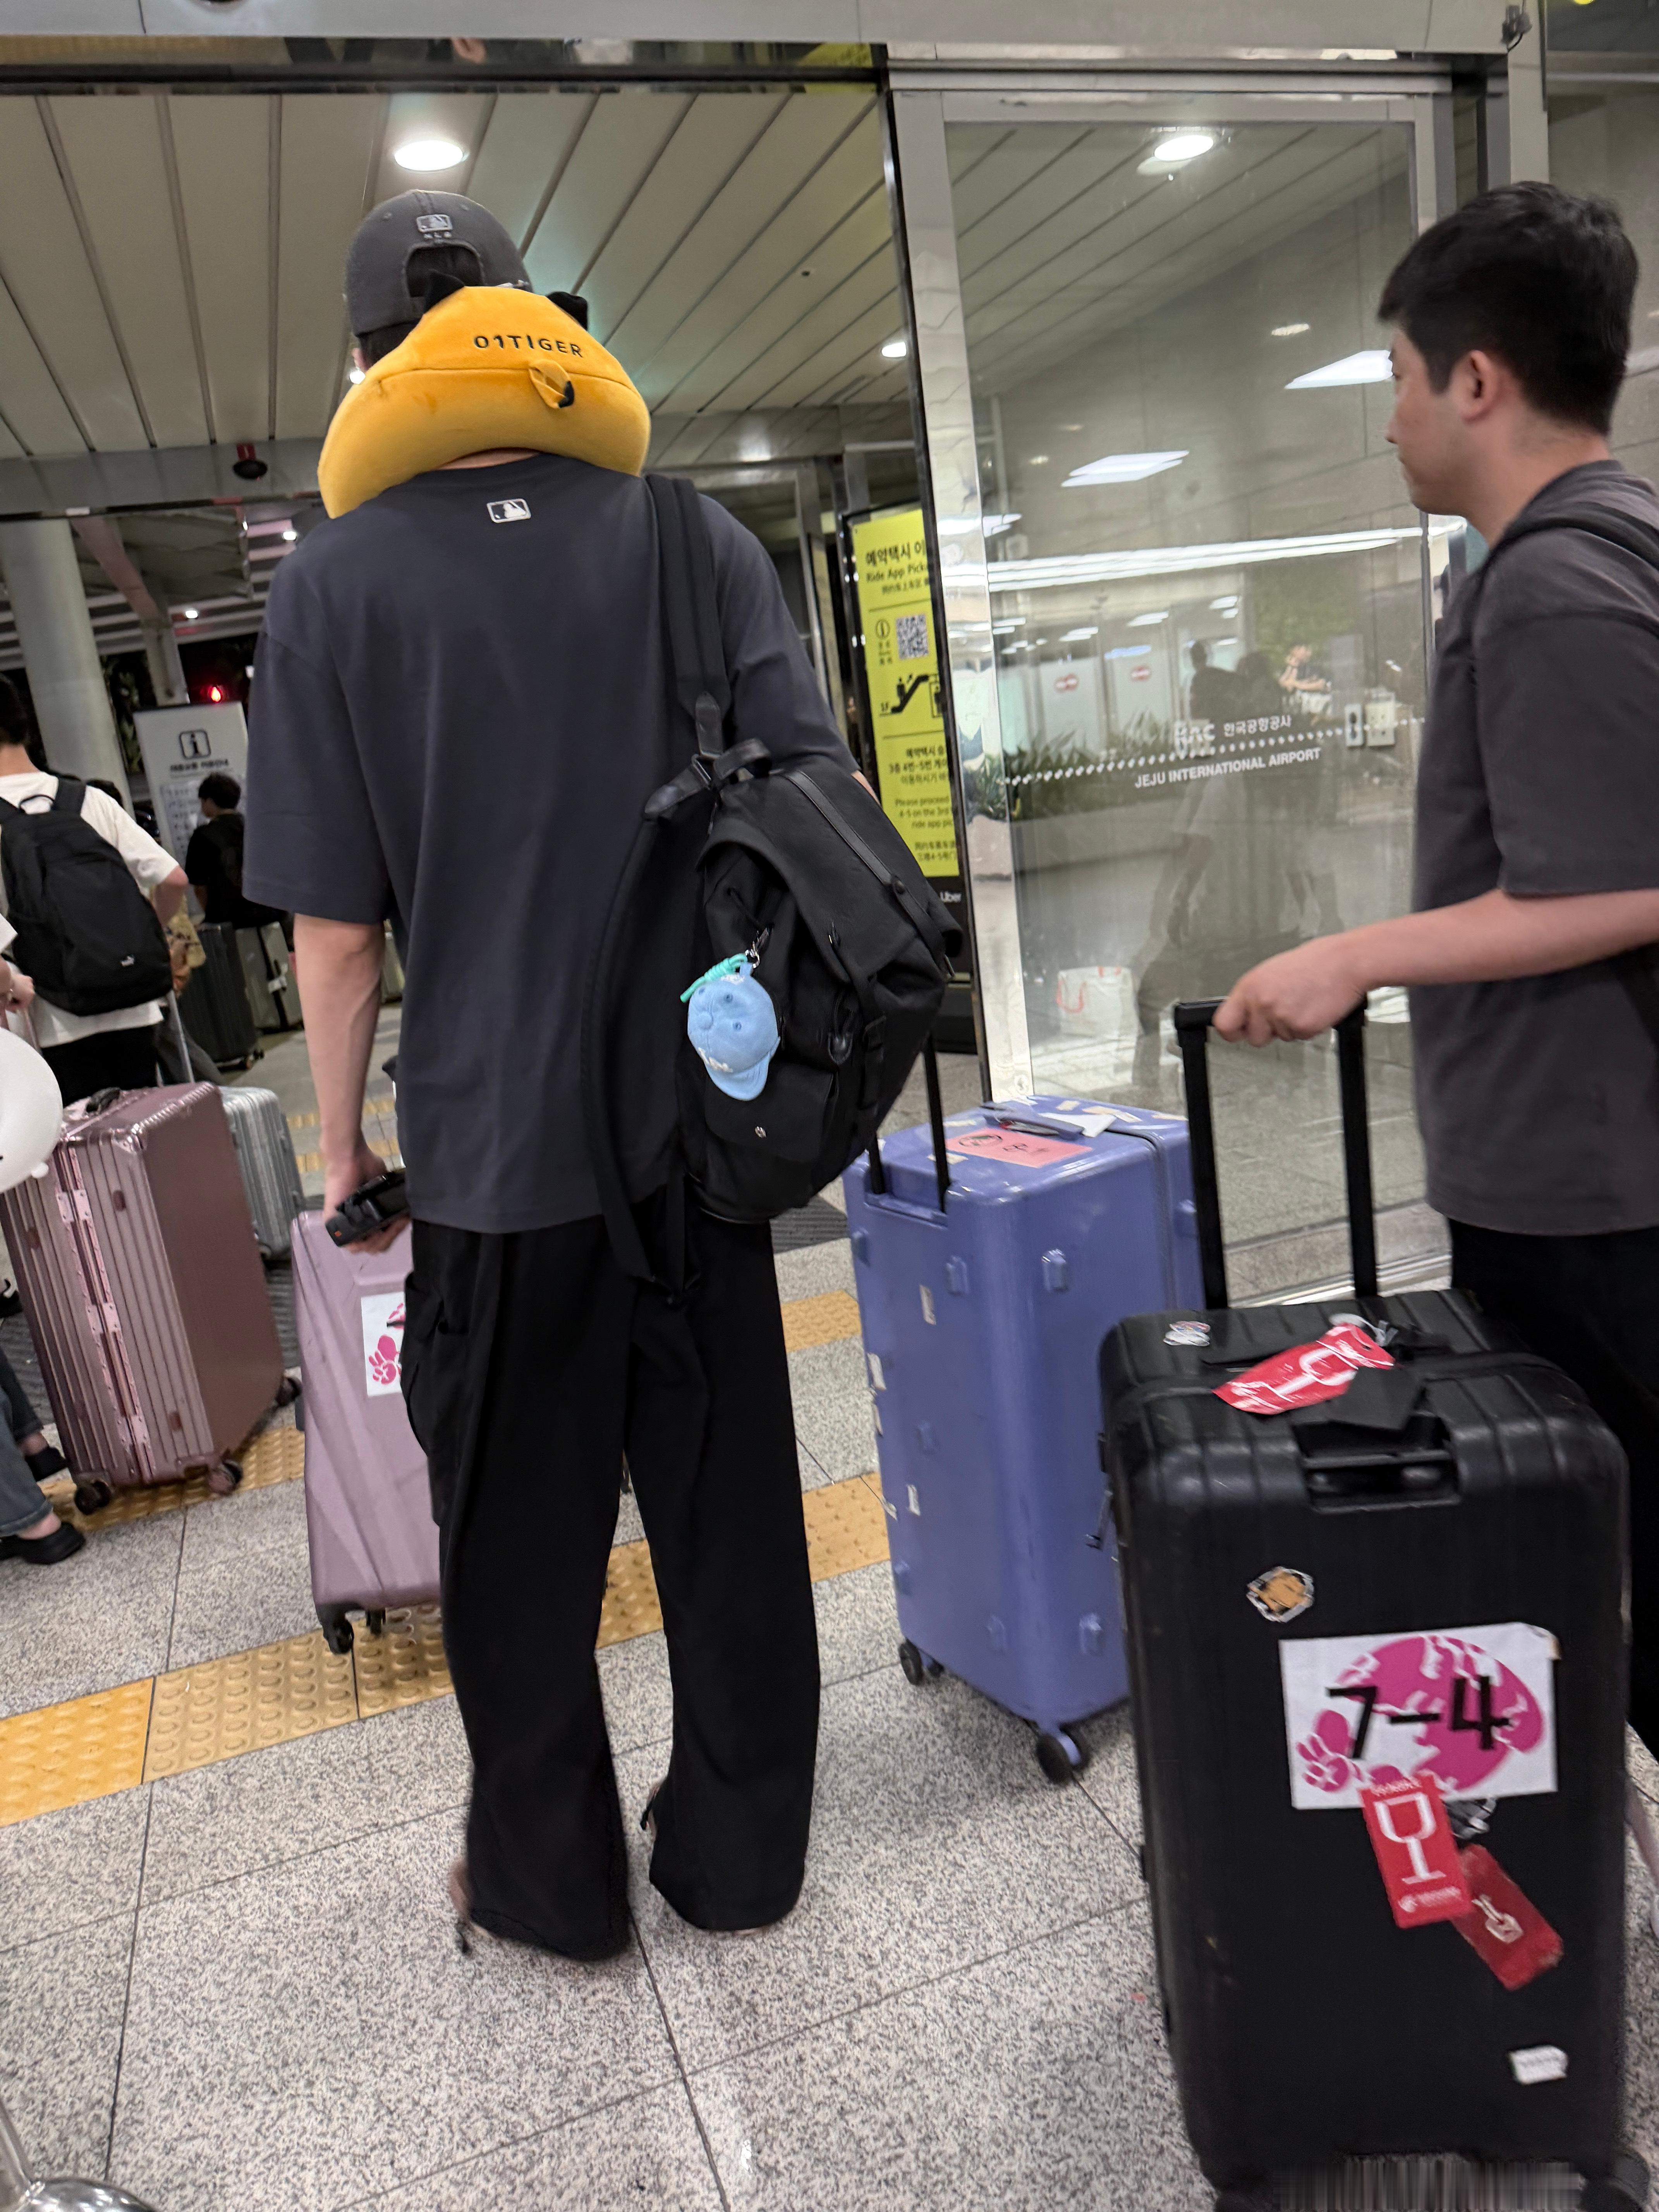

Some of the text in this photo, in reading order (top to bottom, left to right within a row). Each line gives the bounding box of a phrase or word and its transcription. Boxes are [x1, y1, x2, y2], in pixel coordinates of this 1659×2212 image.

[866, 542, 910, 566] 예약택시
[866, 571, 884, 582] Ride
[888, 568, 905, 580] App
[1224, 714, 1291, 737] 한국공항공사
[1135, 747, 1321, 788] JEJU INTERNATIONAL AIRPORT
[939, 891, 962, 903] Uber
[1325, 1675, 1513, 1759] 7-4
